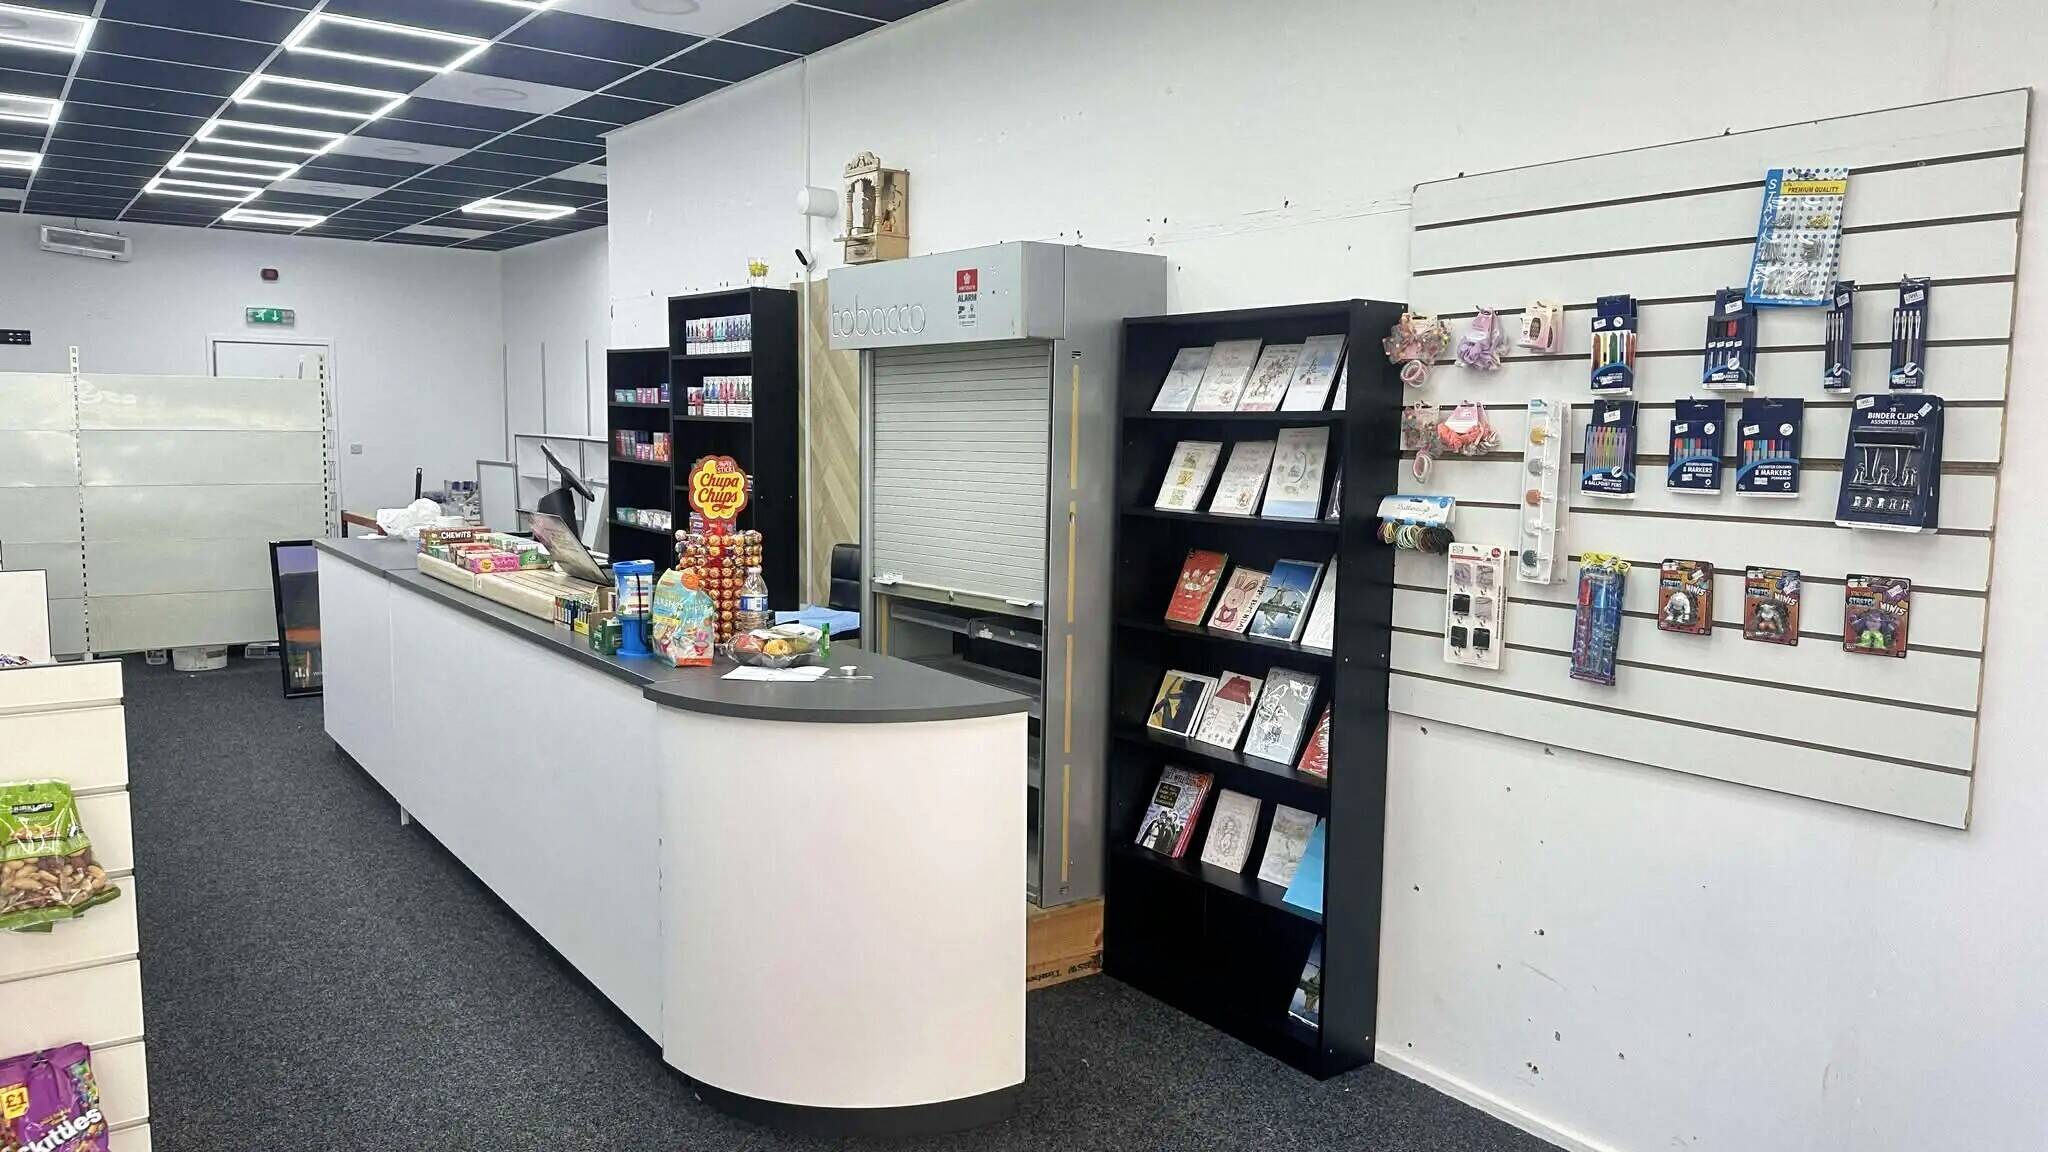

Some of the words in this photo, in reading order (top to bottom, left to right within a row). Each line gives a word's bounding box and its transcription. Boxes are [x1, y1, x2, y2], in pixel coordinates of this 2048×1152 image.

[958, 294, 976, 302] ALARM
[832, 294, 926, 337] tobacco
[1867, 412, 1896, 420] BINDER
[1896, 412, 1919, 420] CLIPS
[1687, 466, 1713, 474] MARKERS
[701, 473, 739, 491] Chupa
[698, 488, 737, 511] Chups
[1774, 592, 1797, 606] MINIS
[1880, 601, 1907, 616] MINIS
[6, 1092, 26, 1108] £1
[17, 1108, 102, 1152] kittles
